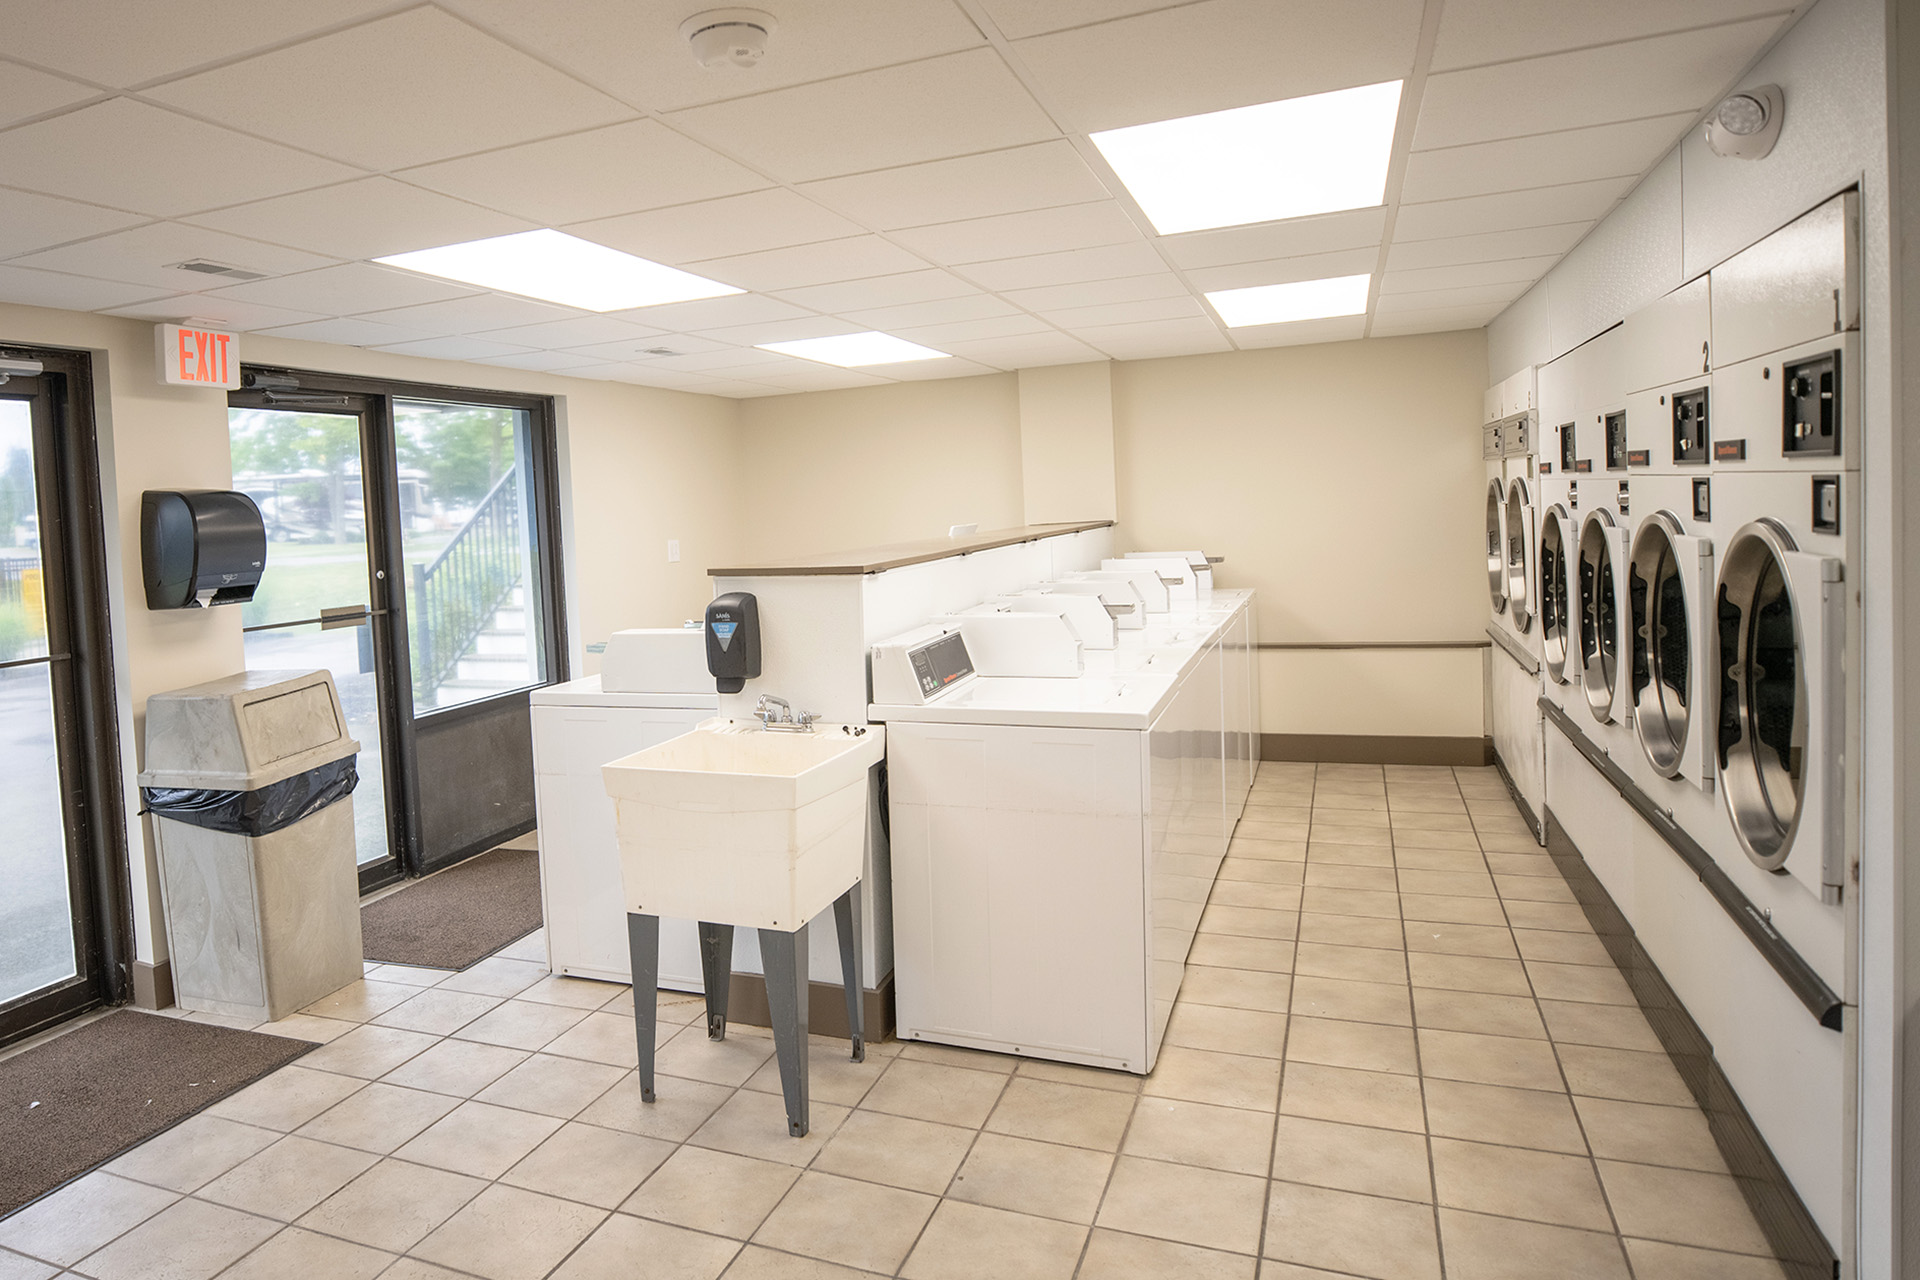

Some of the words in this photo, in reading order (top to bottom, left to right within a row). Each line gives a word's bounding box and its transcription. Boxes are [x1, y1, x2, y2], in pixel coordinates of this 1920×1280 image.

[1834, 289, 1841, 332] 1
[178, 329, 230, 383] EXIT
[1702, 341, 1709, 373] 2
